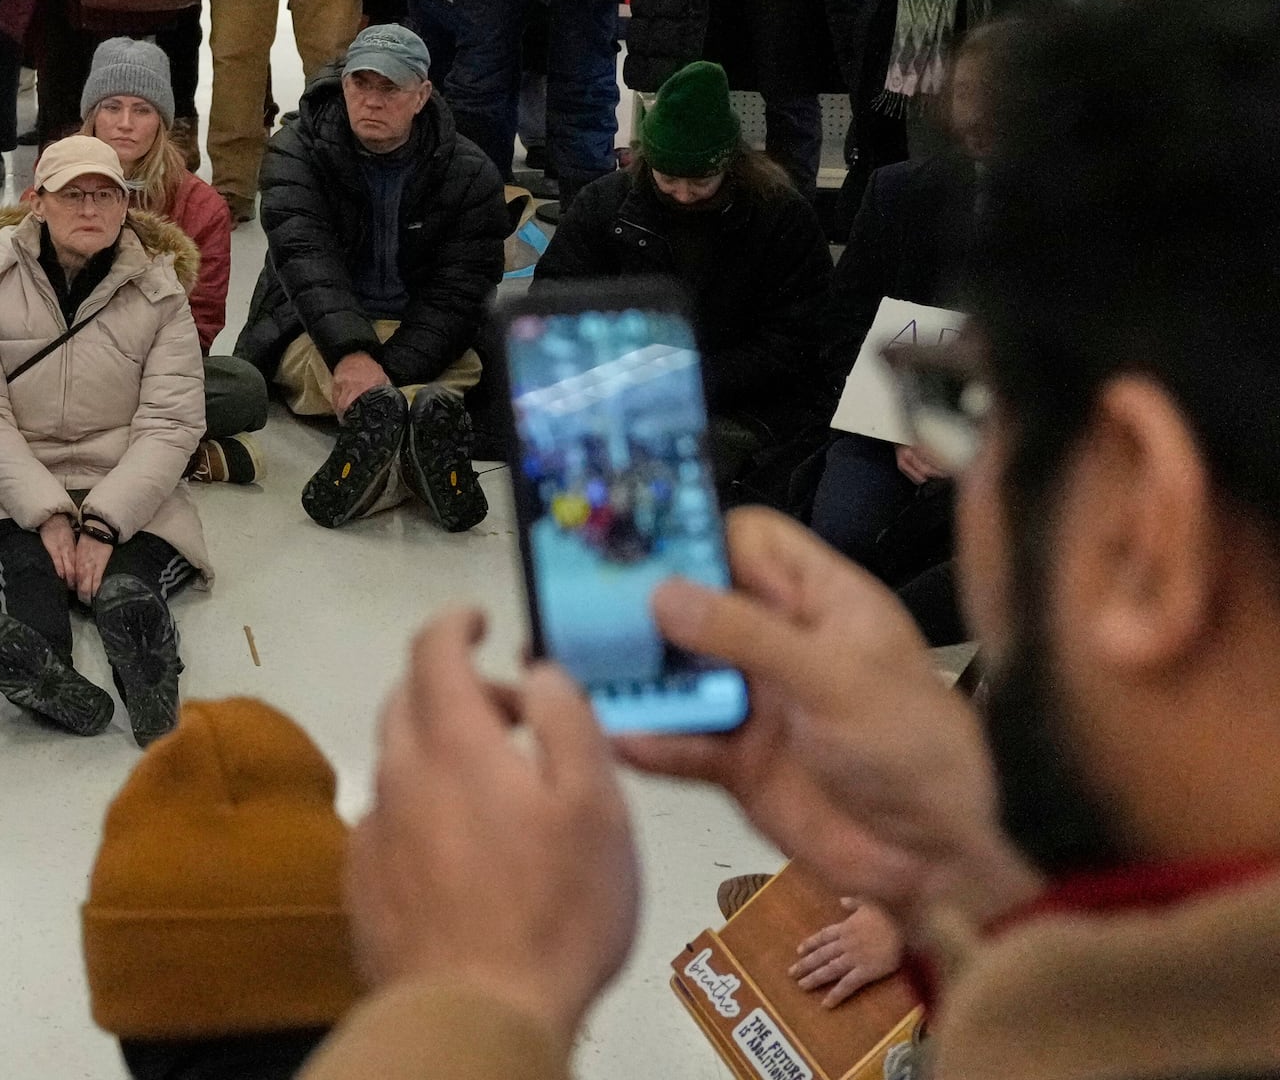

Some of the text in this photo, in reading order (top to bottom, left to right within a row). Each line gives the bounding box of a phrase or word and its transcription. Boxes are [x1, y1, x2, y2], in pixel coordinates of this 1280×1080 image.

[688, 952, 736, 1014] breathe
[738, 1025, 752, 1038] IS
[750, 1015, 807, 1080] THE FUTURE
